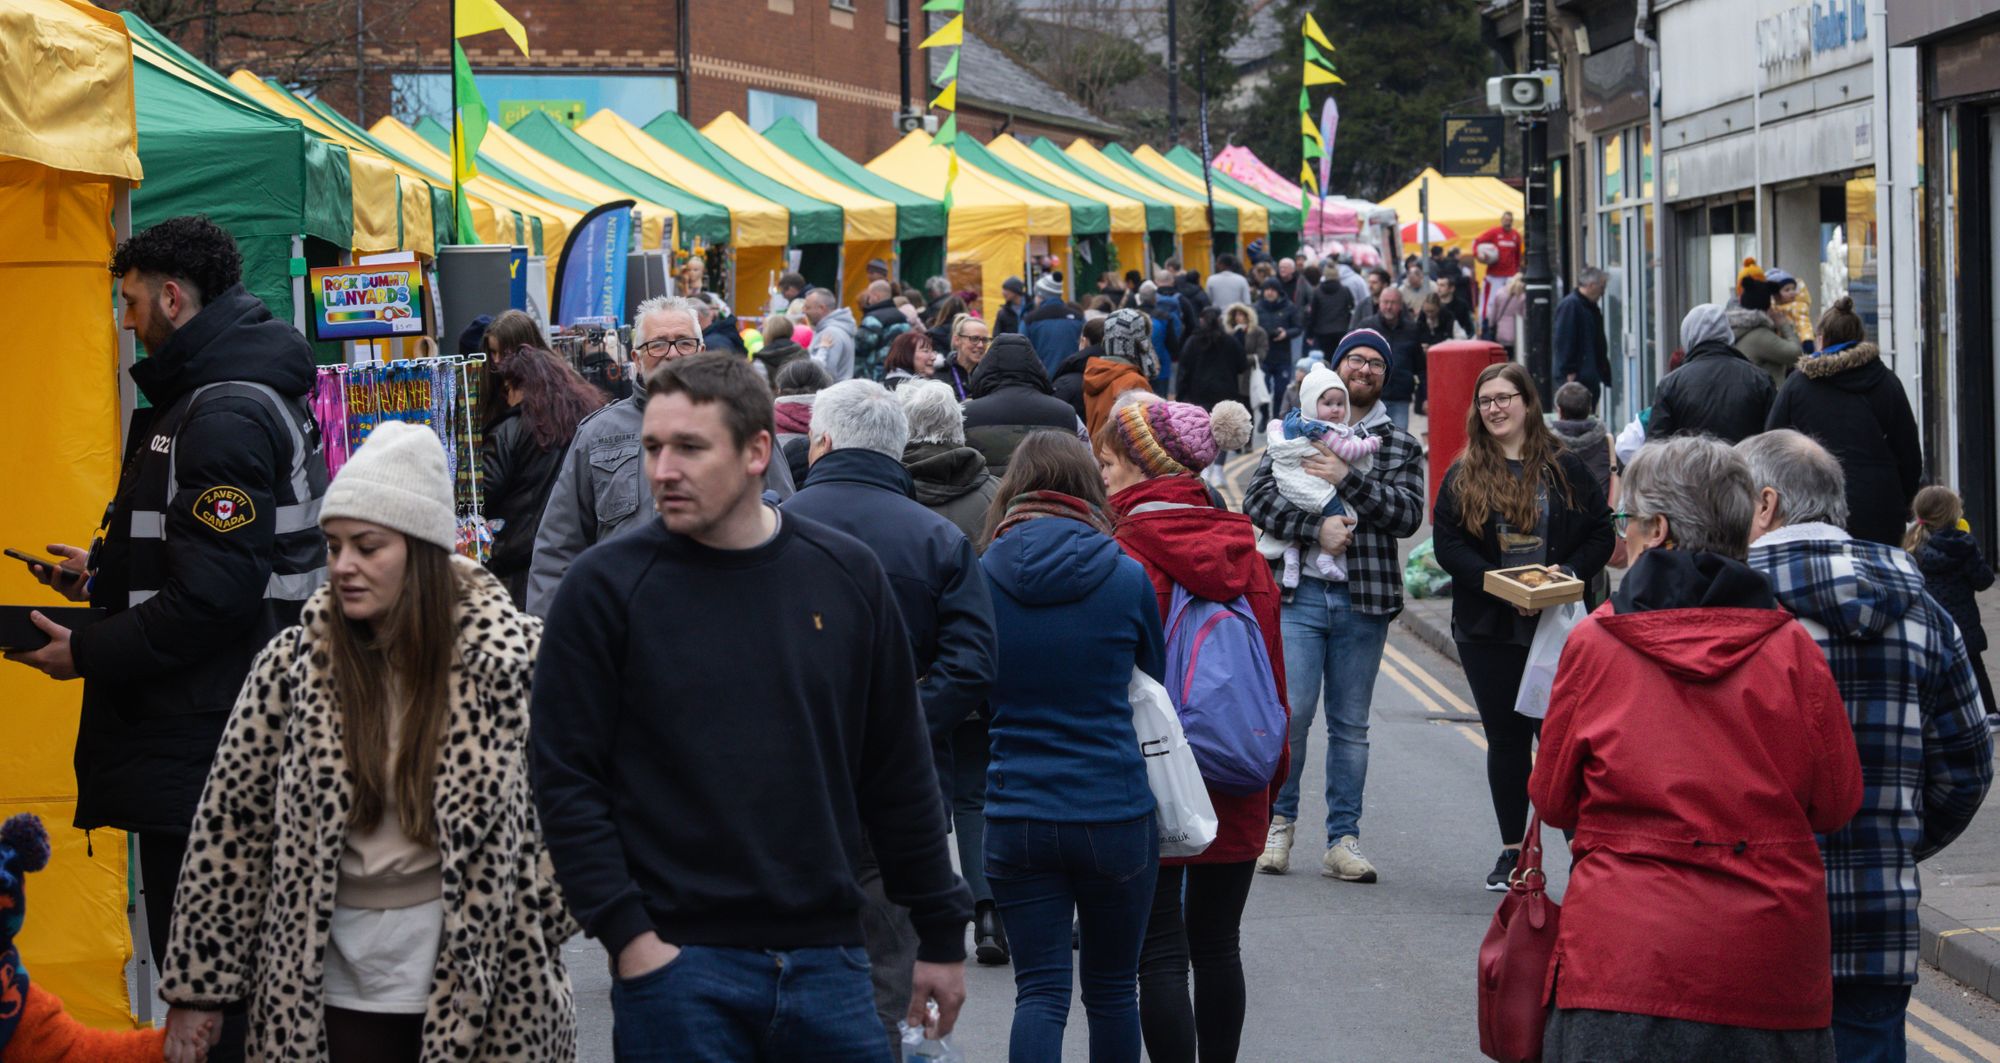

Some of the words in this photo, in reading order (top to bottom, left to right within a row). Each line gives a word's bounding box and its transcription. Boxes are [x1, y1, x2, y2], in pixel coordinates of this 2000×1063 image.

[605, 216, 617, 273] KITCHEN
[324, 276, 358, 291] ROCK
[362, 274, 407, 289] DUMMY
[325, 287, 409, 307] LANYARDS
[603, 275, 614, 317] DMA'S
[204, 490, 247, 507] ZAVETTI
[203, 510, 246, 529] CANADA
